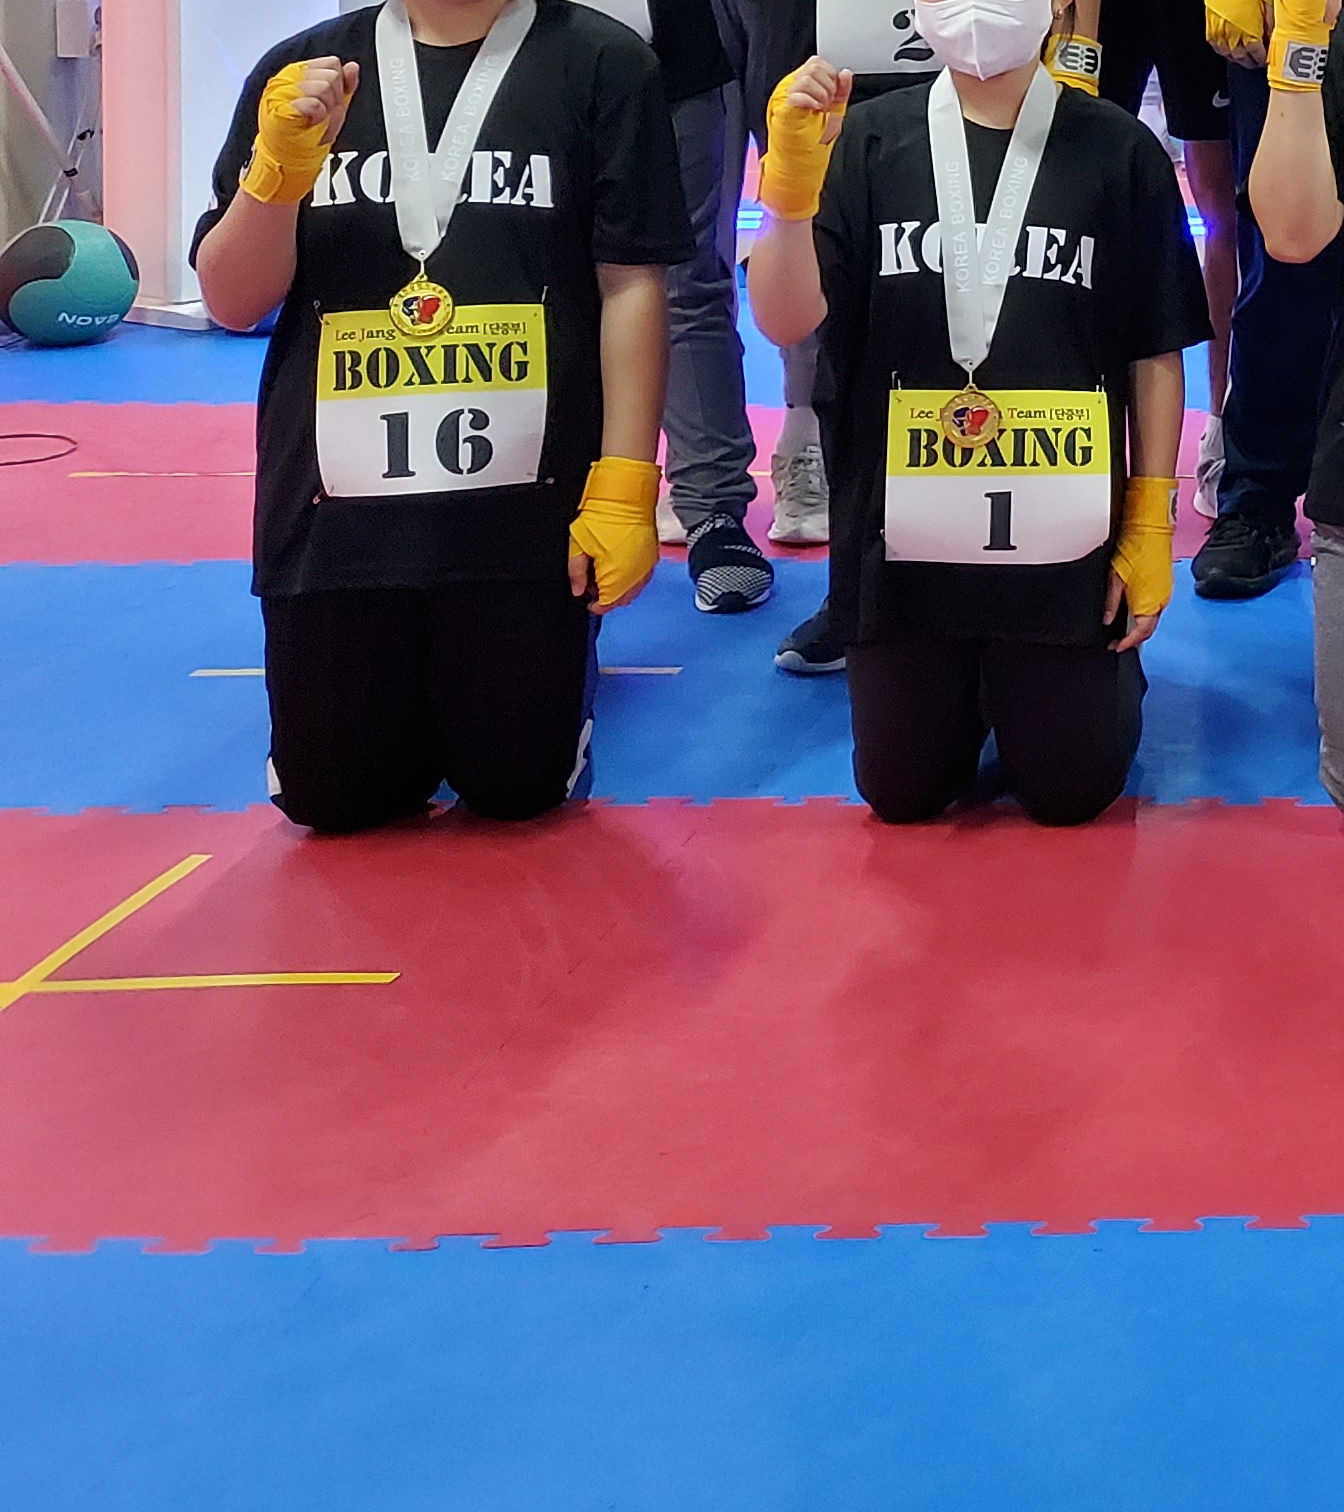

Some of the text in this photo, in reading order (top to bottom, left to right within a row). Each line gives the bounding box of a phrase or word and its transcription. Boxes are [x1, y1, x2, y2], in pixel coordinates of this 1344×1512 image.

[310, 150, 554, 208] KOEA
[878, 220, 1095, 290] KOEA
[335, 329, 356, 342] Lee
[360, 327, 396, 343] Jang
[333, 341, 530, 392] BOXING
[910, 407, 935, 420] Lee
[1007, 408, 1048, 420] Team
[380, 408, 494, 479] 16
[983, 491, 1017, 552] 1
